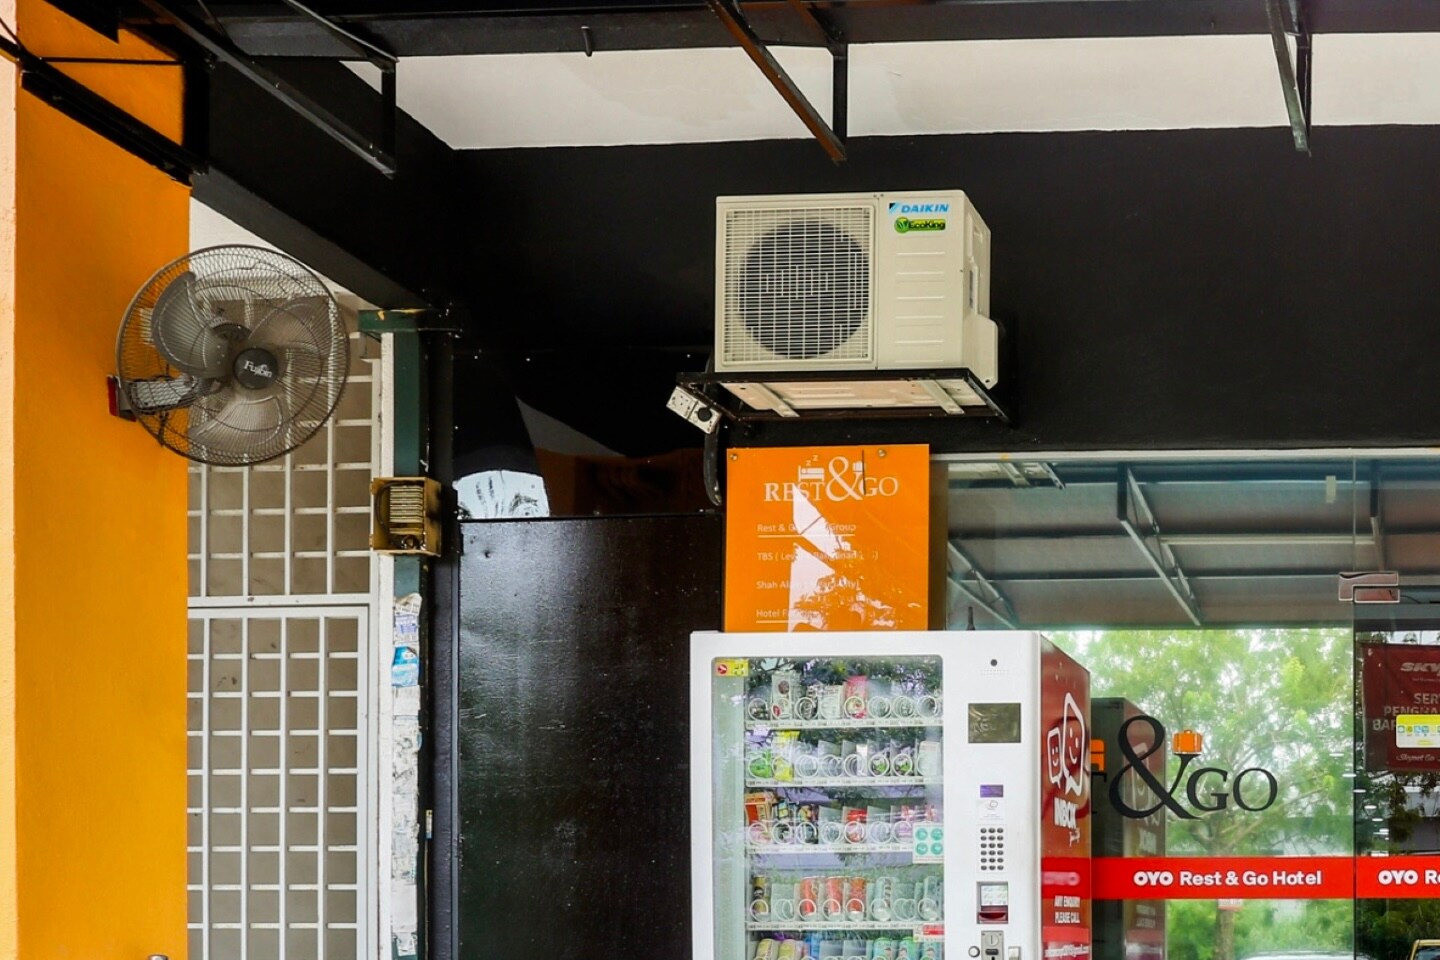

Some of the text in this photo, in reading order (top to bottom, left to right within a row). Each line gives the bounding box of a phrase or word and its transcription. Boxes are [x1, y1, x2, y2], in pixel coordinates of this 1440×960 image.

[901, 204, 949, 213] DAIKIN
[757, 552, 774, 561] TBS
[756, 581, 778, 590] Shah
[756, 608, 781, 618] Hotel
[1134, 870, 1322, 886] OYO Rest & Go Hotel
[1379, 870, 1418, 884] OYO
